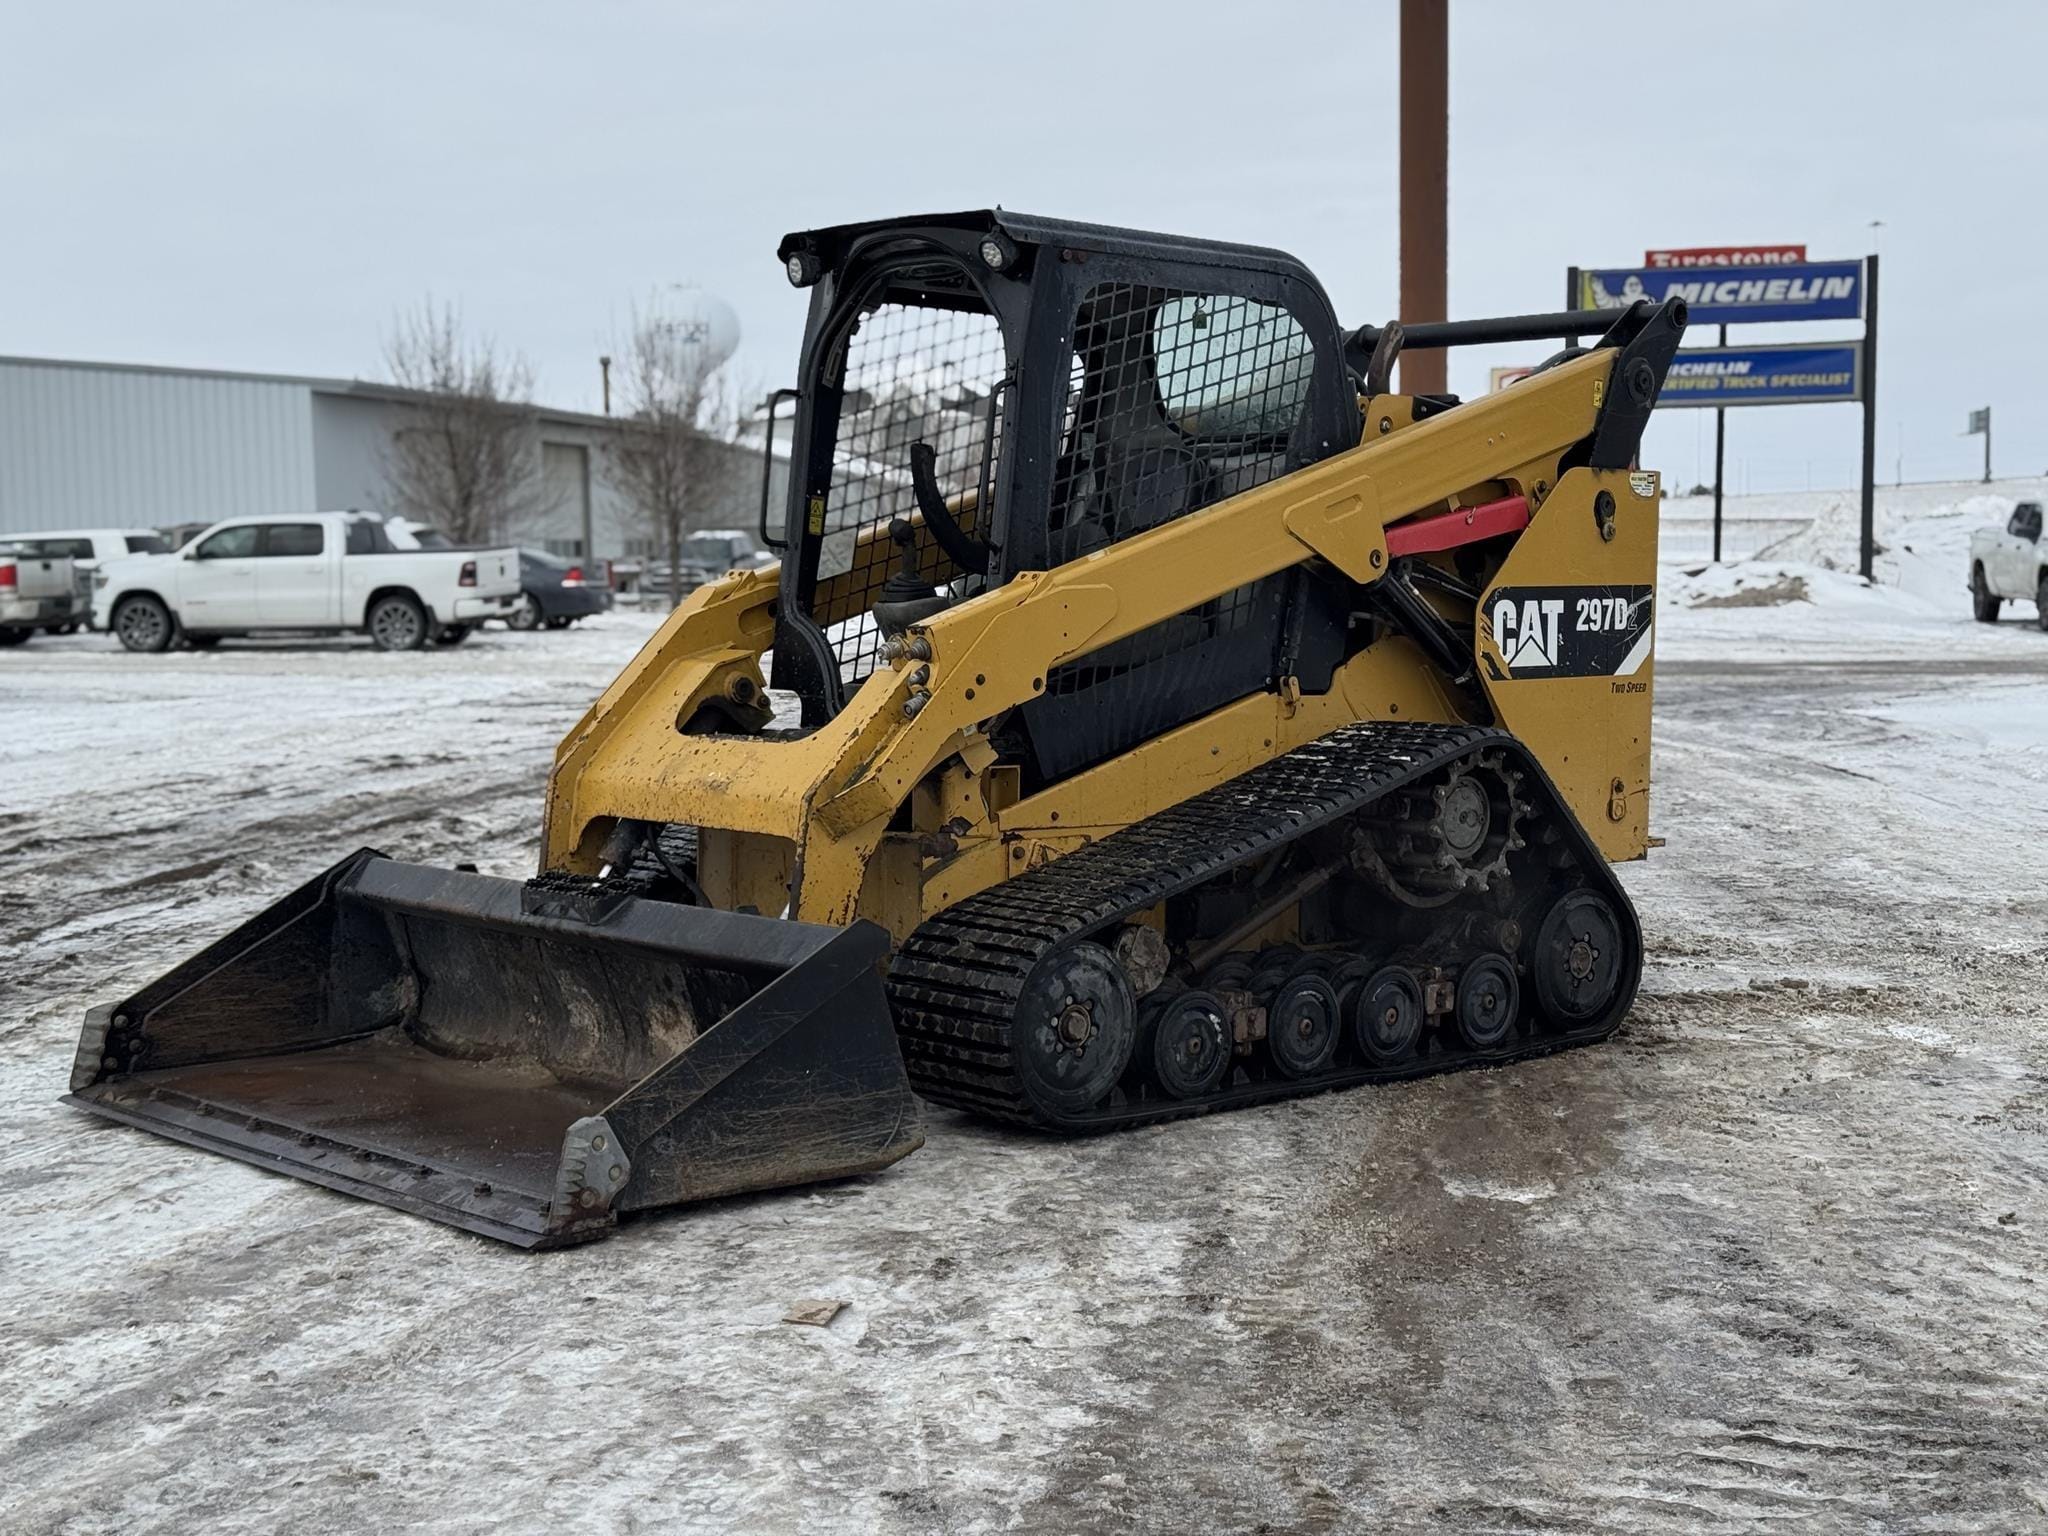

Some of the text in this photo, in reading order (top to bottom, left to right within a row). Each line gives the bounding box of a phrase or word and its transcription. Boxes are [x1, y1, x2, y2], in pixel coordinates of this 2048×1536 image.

[1652, 250, 1798, 267] Firestone
[1662, 276, 1854, 302] MICHELIN
[1669, 361, 1751, 375] ICHELIN
[1661, 373, 1850, 390] ERTIFIED TRUCK SPECIALIST
[1493, 599, 1564, 667] CAT
